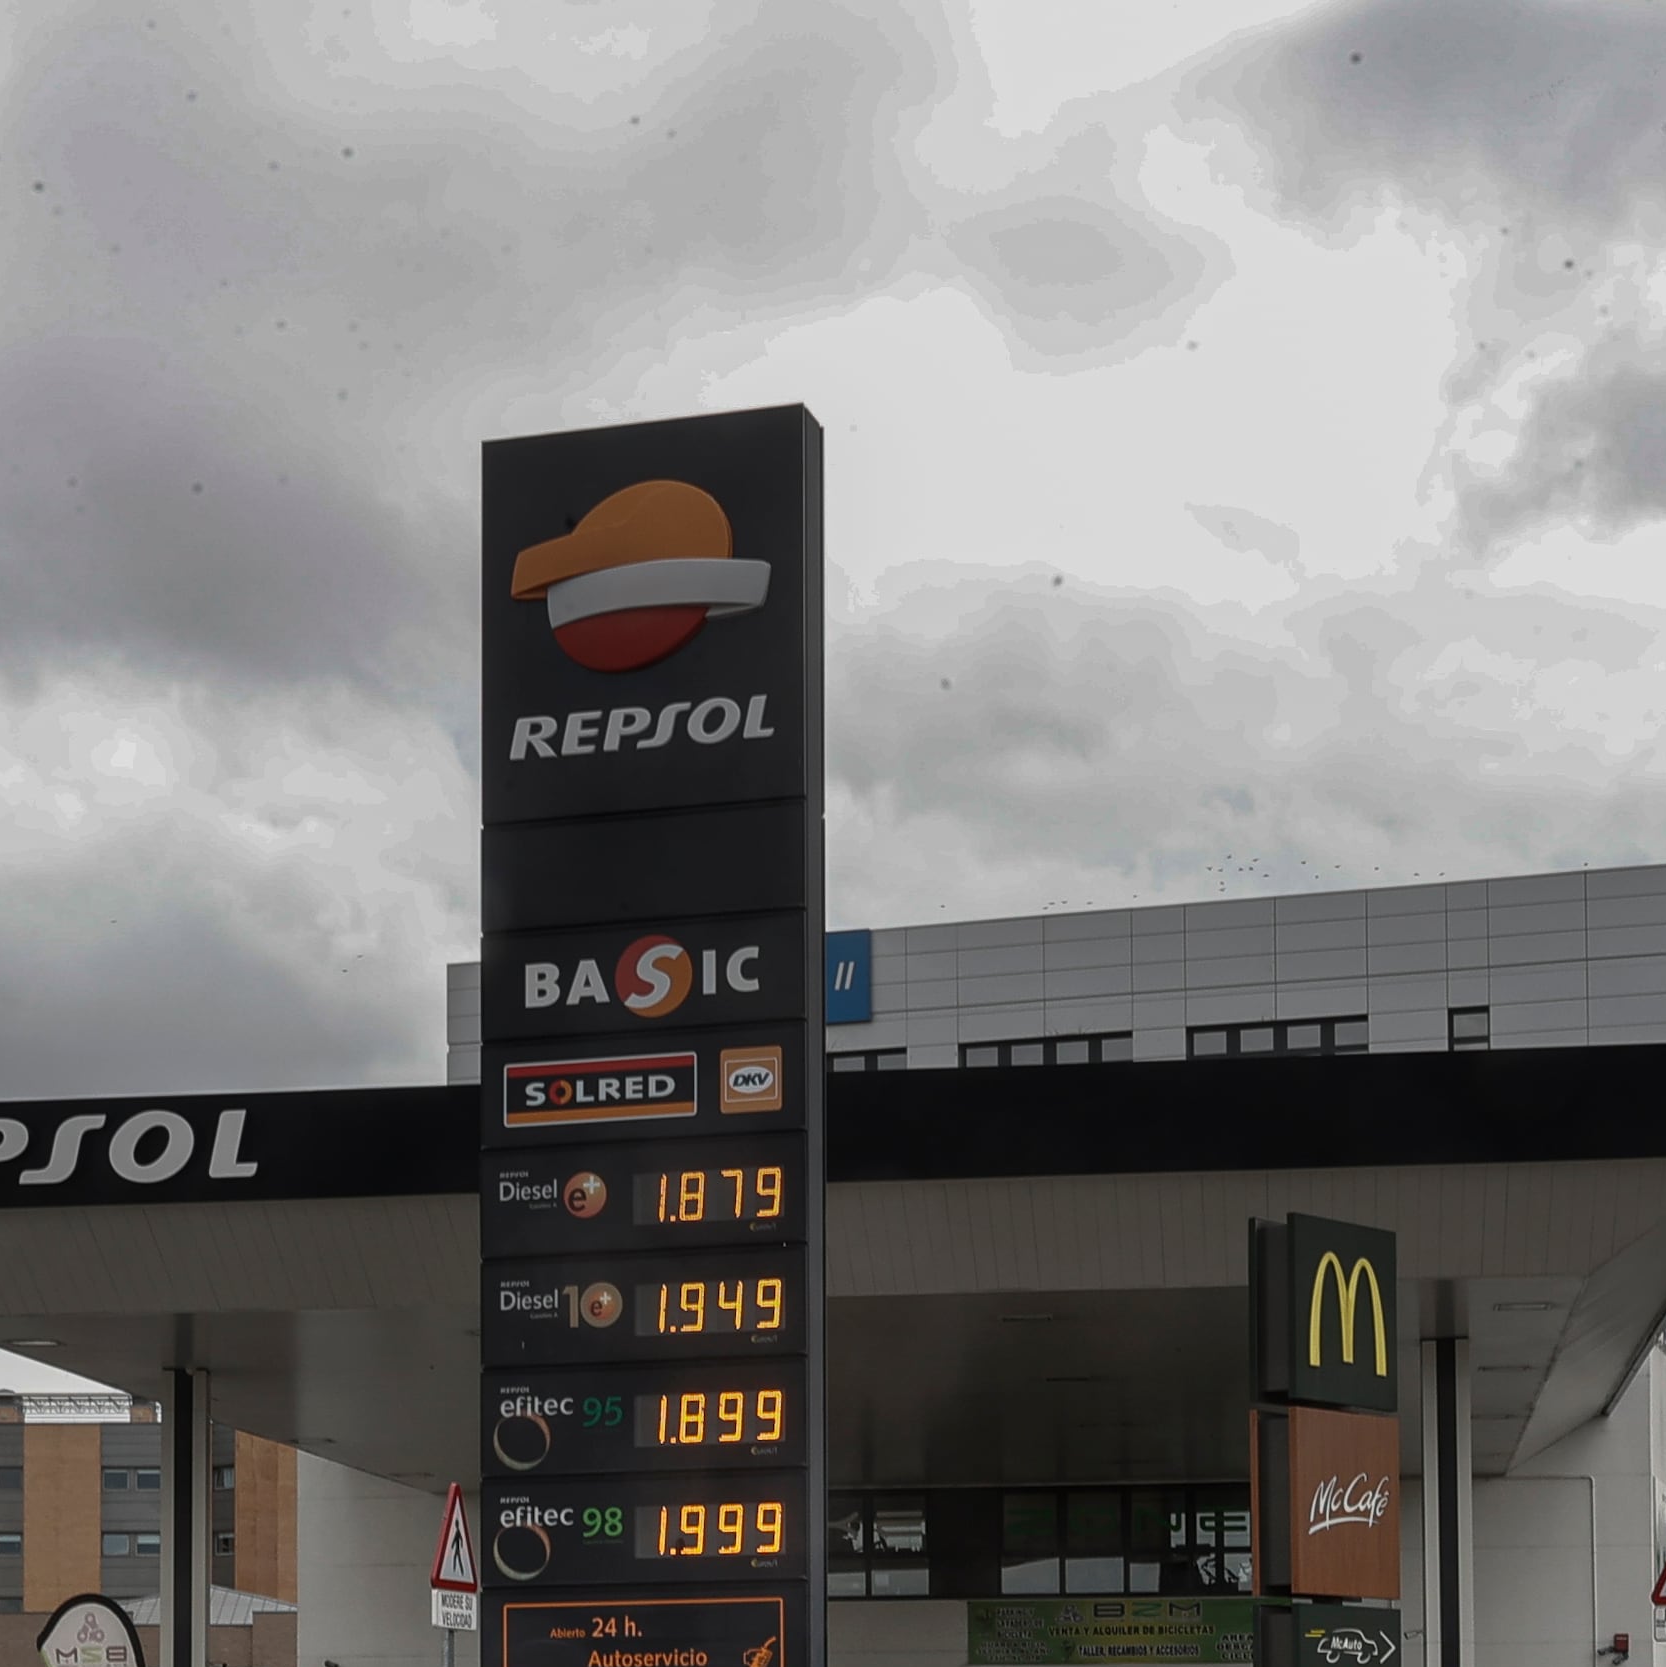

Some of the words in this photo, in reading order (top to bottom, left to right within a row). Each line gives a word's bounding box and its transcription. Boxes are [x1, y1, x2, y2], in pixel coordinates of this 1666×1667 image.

[510, 694, 775, 761] REPSOL
[524, 944, 760, 1009] BASIC
[524, 1074, 677, 1108] SOLRED
[732, 1070, 771, 1088] DKV
[499, 1177, 558, 1203] Diesel
[658, 1165, 783, 1224] 1.879
[500, 1287, 560, 1312] Diesel
[658, 1278, 783, 1334] 1.949
[500, 1396, 574, 1418] efitec
[581, 1396, 625, 1429] 95
[658, 1389, 783, 1446] 1.899
[1309, 1471, 1390, 1528] McCafé
[500, 1506, 574, 1528] efitec
[581, 1506, 625, 1539] 98
[658, 1502, 783, 1556] 1.999
[441, 1610, 473, 1629] VELOCIDAD
[550, 1629, 587, 1639] Abierto
[591, 1616, 618, 1638] 24
[624, 1615, 644, 1638] h.
[1048, 1626, 1080, 1637] VENTA
[1083, 1626, 1089, 1637] Y
[1092, 1625, 1140, 1636] ALQUILER
[1143, 1625, 1155, 1635] DE
[1158, 1624, 1215, 1635] BICICLETAS
[1108, 1645, 1147, 1657] RECAMBIOS
[1156, 1645, 1200, 1656] ACCESORIOS
[1330, 1635, 1363, 1651] McAuto
